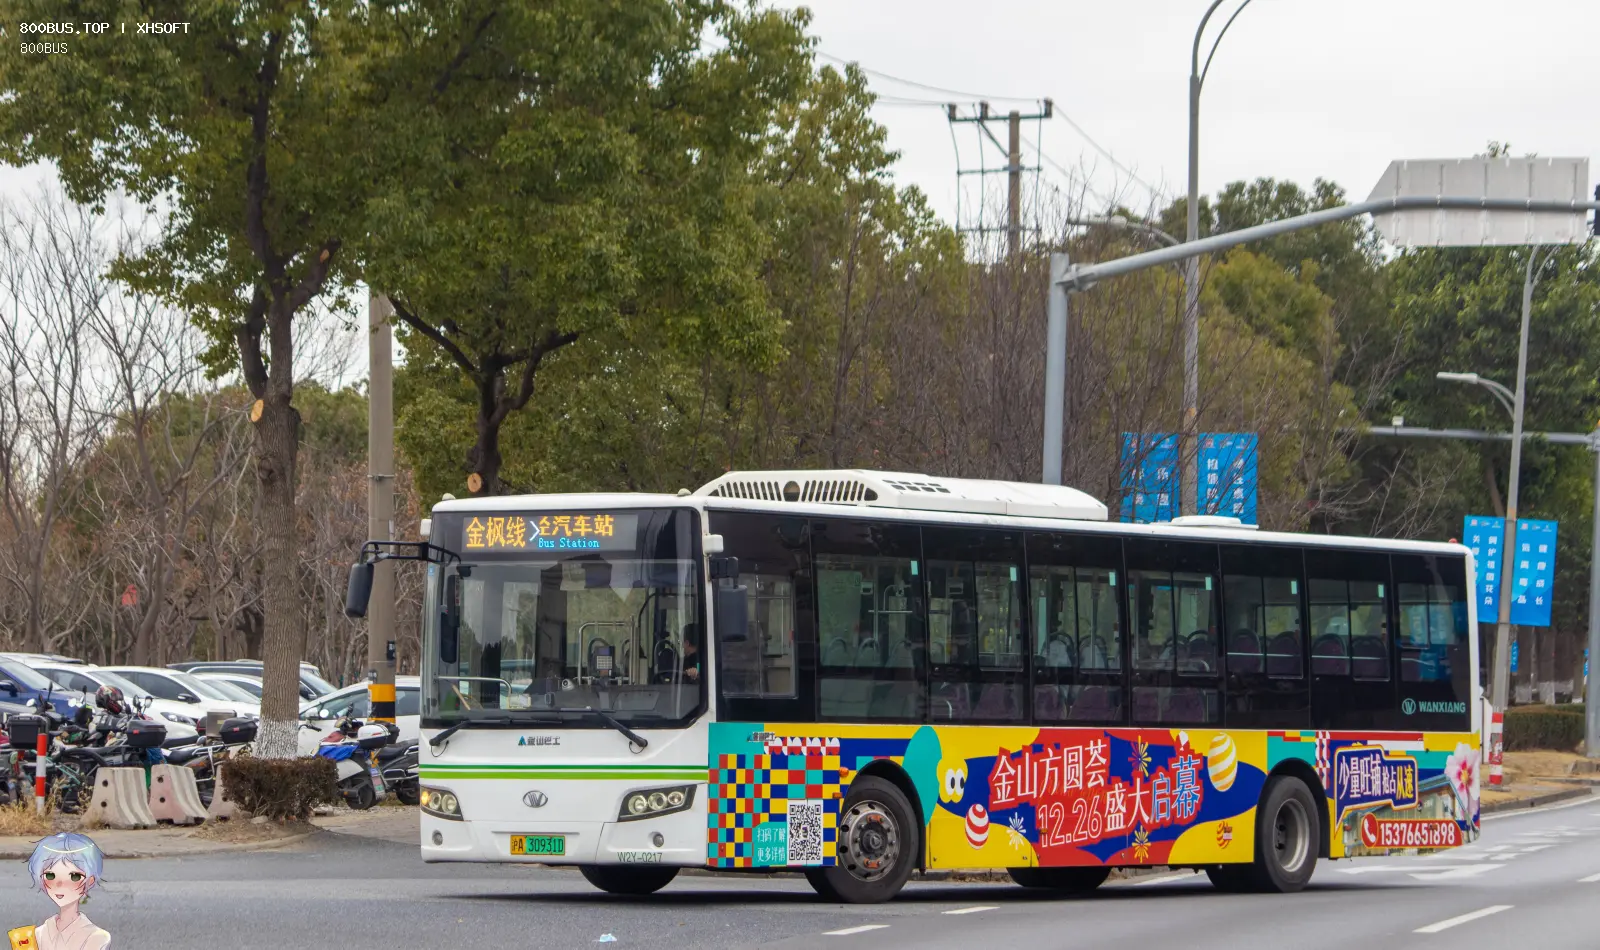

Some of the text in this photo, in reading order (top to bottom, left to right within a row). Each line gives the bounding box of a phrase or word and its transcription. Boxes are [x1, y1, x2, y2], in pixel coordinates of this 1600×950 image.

[466, 516, 526, 548] 金枫线
[538, 537, 600, 548] Bus Station
[1418, 701, 1466, 714] WANXIANG
[527, 735, 561, 746] 金山巴士
[992, 738, 1107, 804] 金山方圆荟
[757, 827, 786, 843] 扫码了解
[1380, 822, 1455, 845] 15376651898
[617, 851, 663, 863] W2Y-0217
[757, 846, 786, 863] 更多详情
